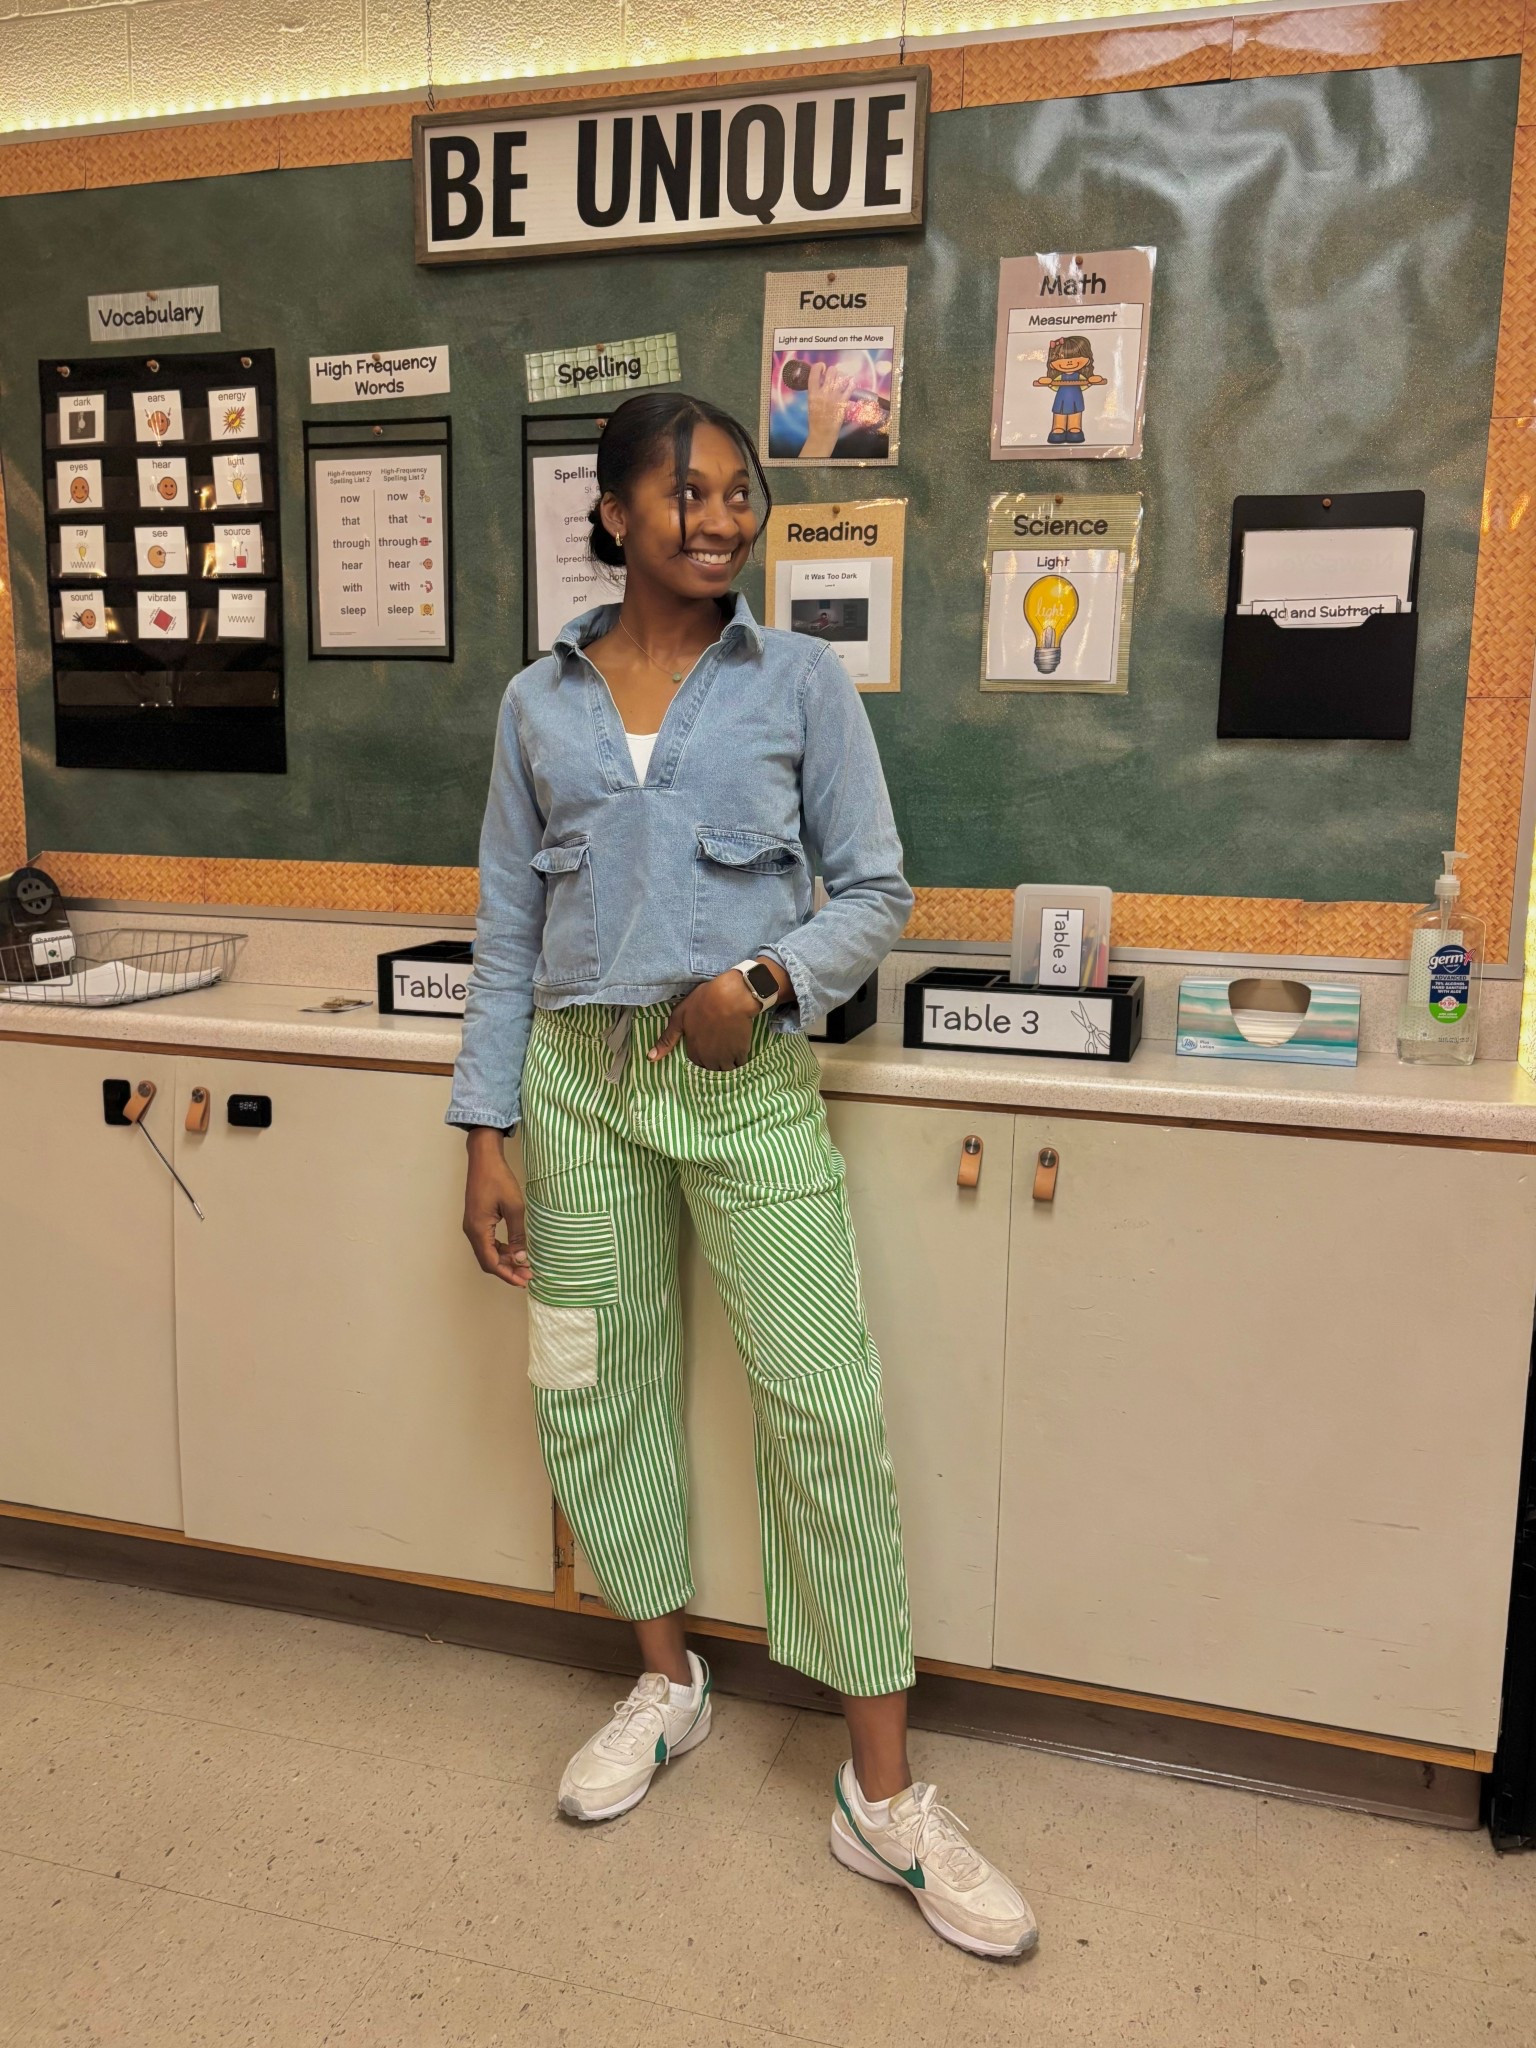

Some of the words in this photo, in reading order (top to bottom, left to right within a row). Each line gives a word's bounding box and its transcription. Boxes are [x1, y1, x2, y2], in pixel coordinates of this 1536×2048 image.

[429, 130, 528, 243] BE
[576, 93, 906, 228] UNIQUE
[1040, 272, 1106, 296] Math
[799, 290, 867, 310] Focus
[98, 301, 204, 327] Vocabulary
[1028, 311, 1117, 326] Measurement
[778, 335, 798, 344] Light
[799, 335, 813, 343] and
[814, 335, 837, 343] Sound
[863, 334, 884, 342] Move
[315, 359, 352, 381] High
[356, 354, 437, 376] Frequency
[558, 356, 642, 388] Spelling
[354, 377, 405, 397] Words
[147, 394, 166, 403] ears
[217, 391, 247, 401] energy
[73, 398, 92, 407] dark
[69, 463, 89, 473] eyes
[152, 460, 171, 469] hear
[227, 457, 245, 468] light
[554, 466, 598, 483] Spellin
[340, 495, 361, 504] now
[387, 492, 409, 502] now
[341, 516, 361, 526] that
[388, 514, 408, 524] that
[1013, 514, 1109, 536] Science
[75, 528, 89, 538] ray
[152, 530, 168, 538] see
[223, 528, 251, 536] source
[787, 521, 878, 547] Reading
[332, 538, 371, 550] through
[378, 536, 418, 549] through
[565, 534, 589, 543] clove
[341, 560, 363, 570] hear
[388, 559, 411, 569] hear
[1036, 556, 1070, 570] Light
[561, 572, 598, 583] rainbow
[841, 572, 858, 580] Dark
[342, 582, 363, 593] with
[389, 581, 410, 592] with
[70, 592, 94, 601] sound
[147, 593, 177, 602] vibrate
[231, 593, 253, 601] wave
[572, 594, 588, 604] pot
[340, 606, 367, 617] sleep
[387, 604, 414, 616] sleep
[1034, 596, 1065, 618] light
[1260, 607, 1287, 619] Add
[1290, 606, 1316, 619] and
[1319, 604, 1385, 618] Subtract
[1052, 910, 1071, 958] Table
[1052, 963, 1067, 974] 3
[394, 973, 467, 1001] Table
[925, 1003, 1012, 1034] Table
[1021, 1010, 1040, 1035] 3
